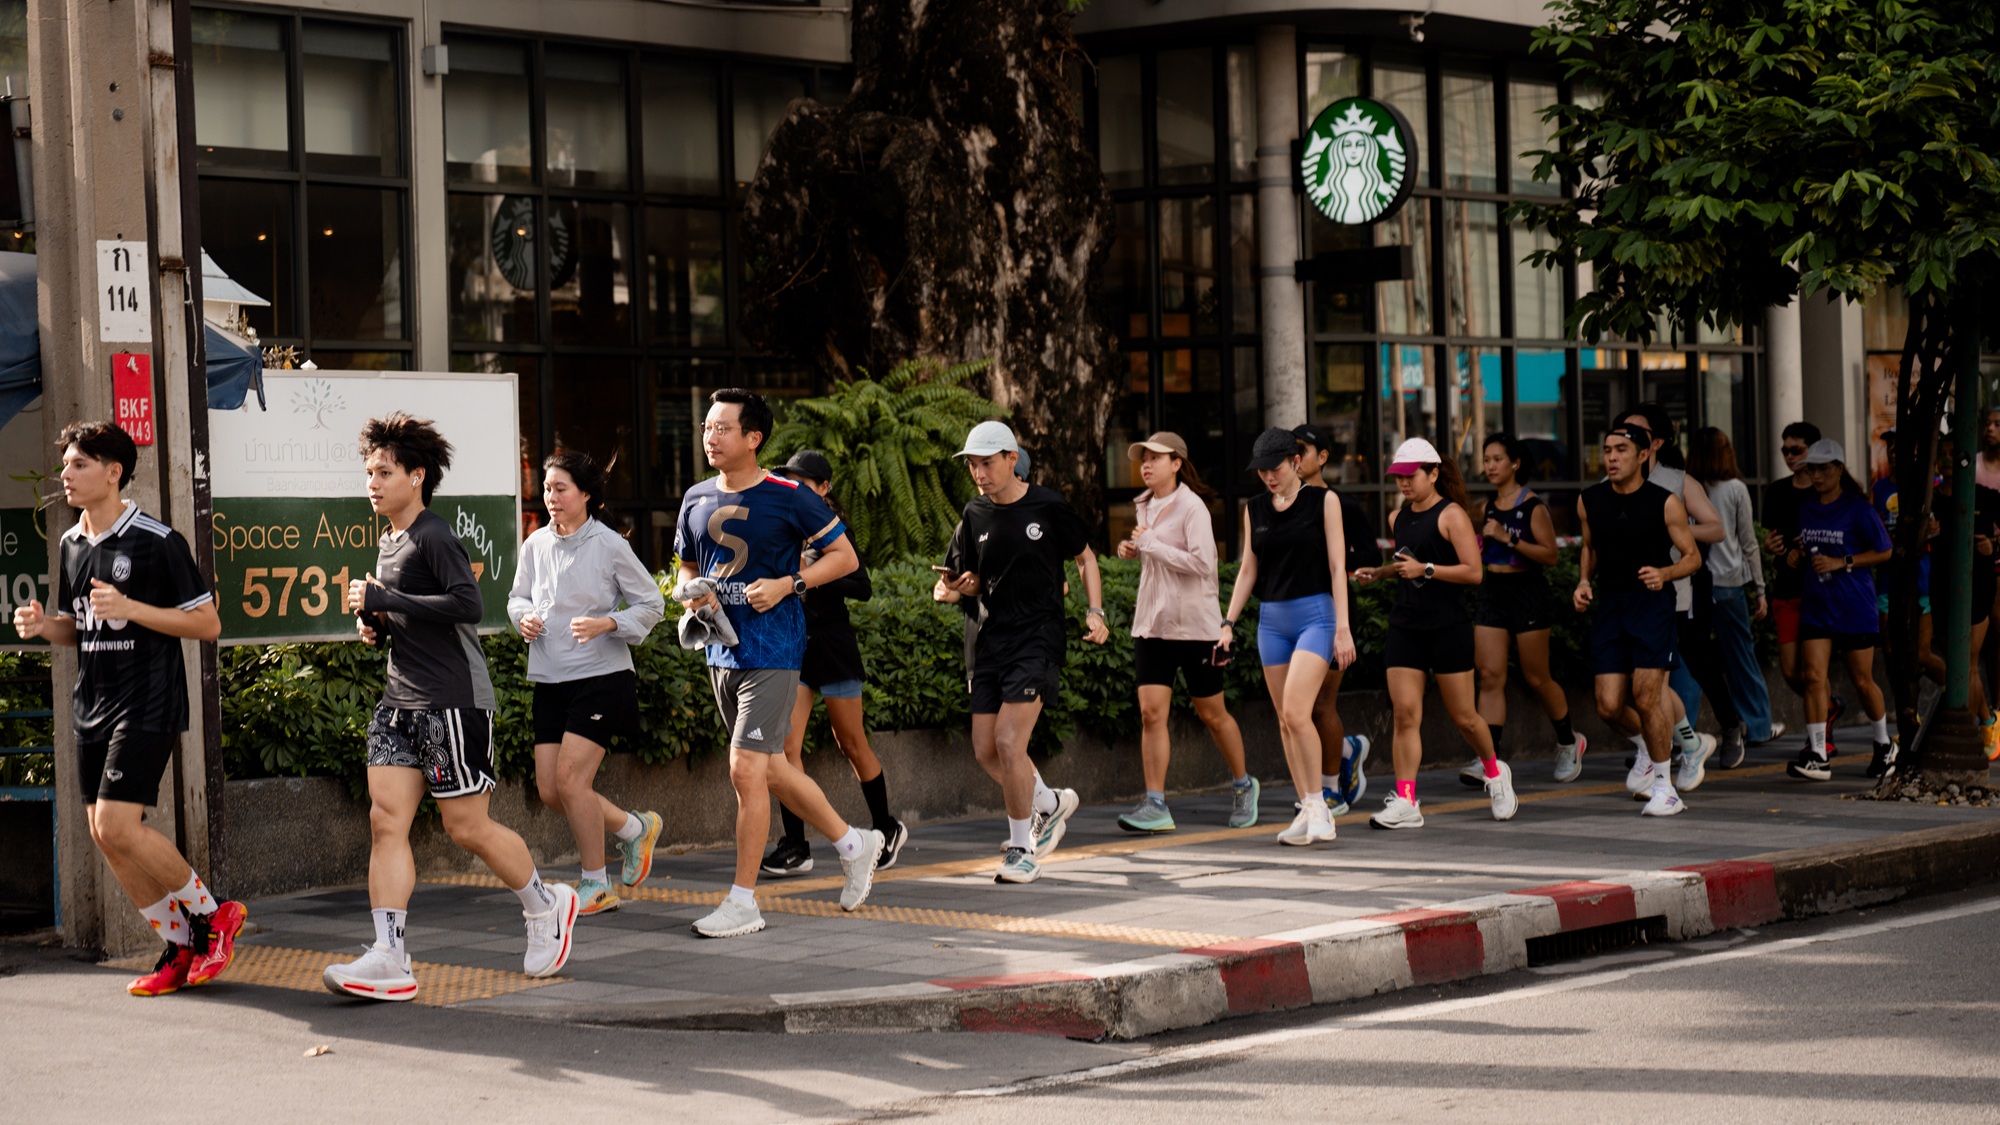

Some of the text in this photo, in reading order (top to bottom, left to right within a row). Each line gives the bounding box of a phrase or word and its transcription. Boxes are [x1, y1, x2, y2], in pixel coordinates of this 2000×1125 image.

[108, 285, 138, 312] 114
[119, 398, 149, 418] BKF
[212, 512, 300, 562] Space
[708, 505, 749, 577] S
[1806, 536, 1844, 545] FITNESS
[1807, 530, 1844, 538] ANYTIME
[242, 565, 350, 618] 5731
